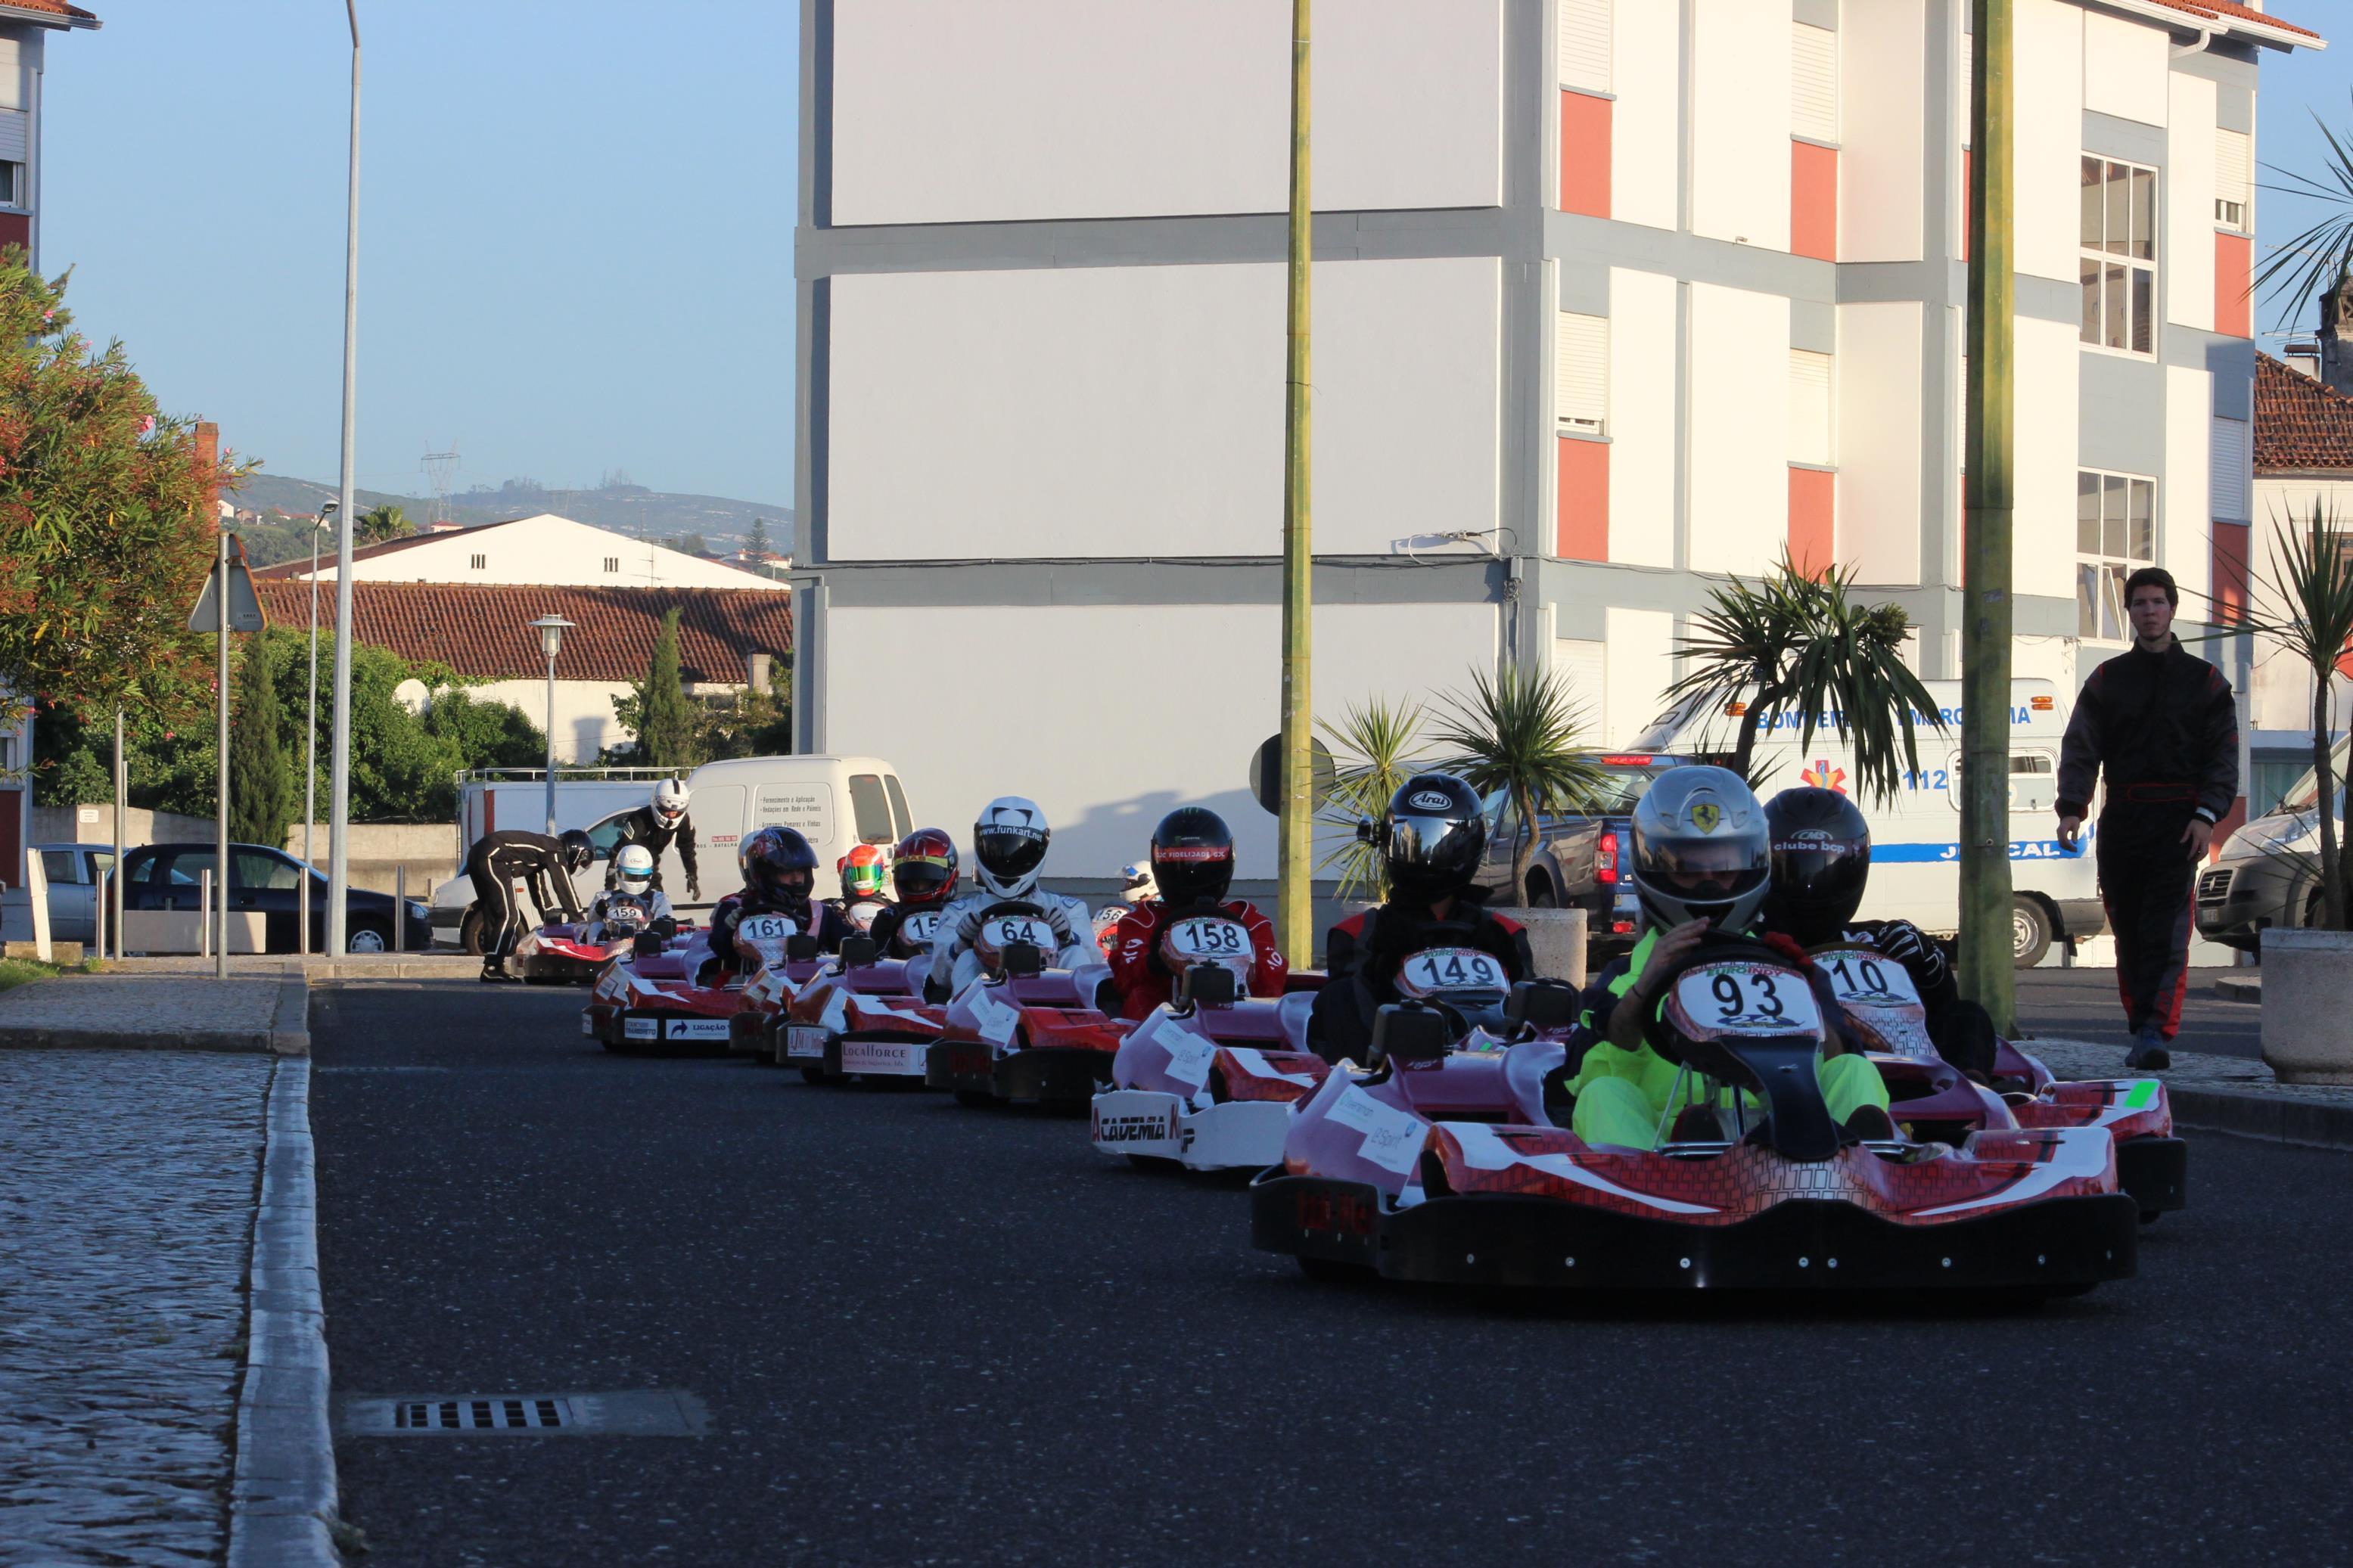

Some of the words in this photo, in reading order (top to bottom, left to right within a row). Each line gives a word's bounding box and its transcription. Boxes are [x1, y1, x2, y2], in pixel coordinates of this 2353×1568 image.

[1902, 769, 1947, 790] 112
[1413, 793, 1447, 806] Arai
[980, 825, 1043, 842] www.funkart.net
[1773, 840, 1817, 852] clube
[1820, 840, 1846, 855] bcp
[1940, 842, 2061, 859] JCAL
[614, 908, 636, 918] 159
[747, 919, 785, 939] 161
[1001, 921, 1037, 943] 64
[1186, 924, 1241, 949] 158
[1822, 952, 1887, 964] EUROINDY
[1422, 955, 1495, 984] 149
[1705, 965, 1785, 978] EUROINDY
[1832, 958, 1891, 995] 10
[1711, 973, 1784, 1017] 93
[692, 1023, 726, 1034] LIGAÇÃO
[1092, 1107, 1166, 1143] ACADEMIA
